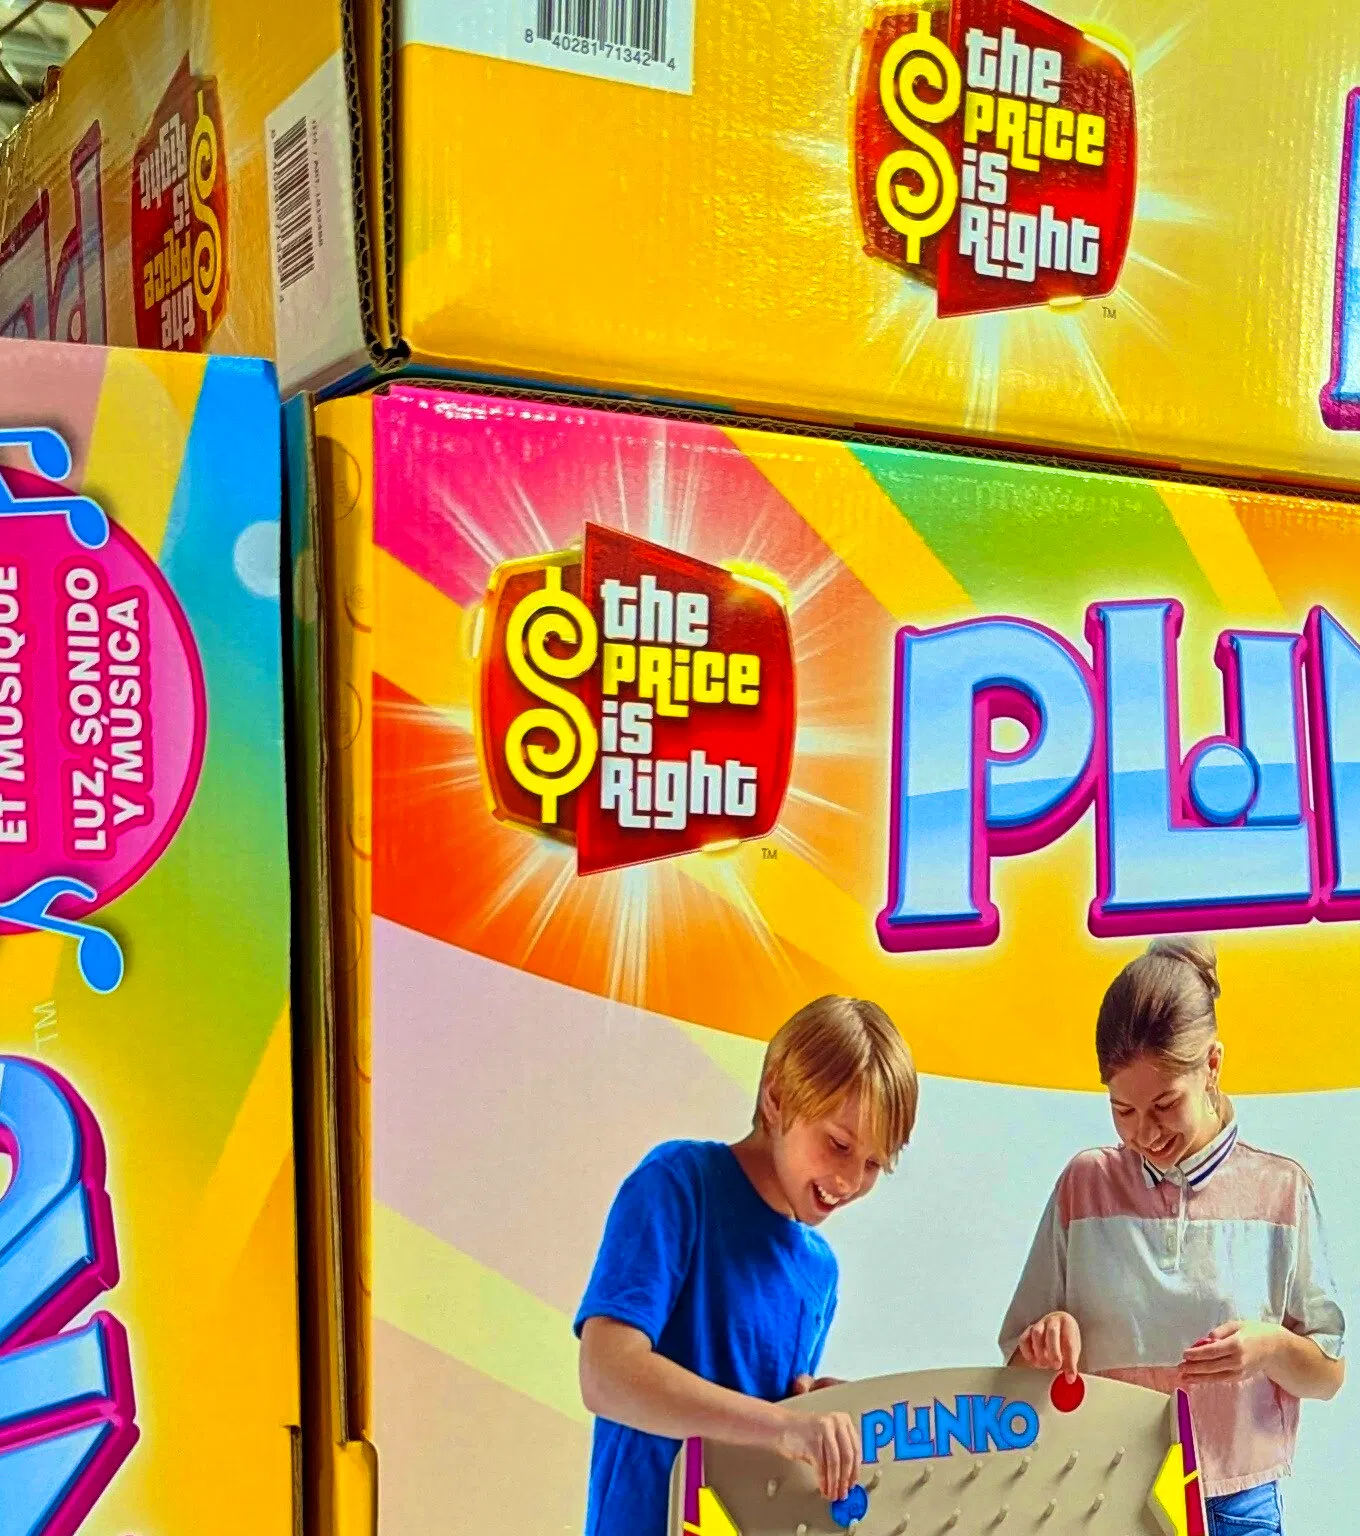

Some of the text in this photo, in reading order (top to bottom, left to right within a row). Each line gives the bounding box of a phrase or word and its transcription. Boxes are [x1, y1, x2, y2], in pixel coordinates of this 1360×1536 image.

[966, 27, 1062, 102] the
[963, 148, 1008, 205] is
[959, 202, 1100, 283] Right
[600, 575, 709, 646] the
[602, 701, 653, 755] is
[600, 750, 758, 831] Right
[861, 1394, 1040, 1464] PLINKO
